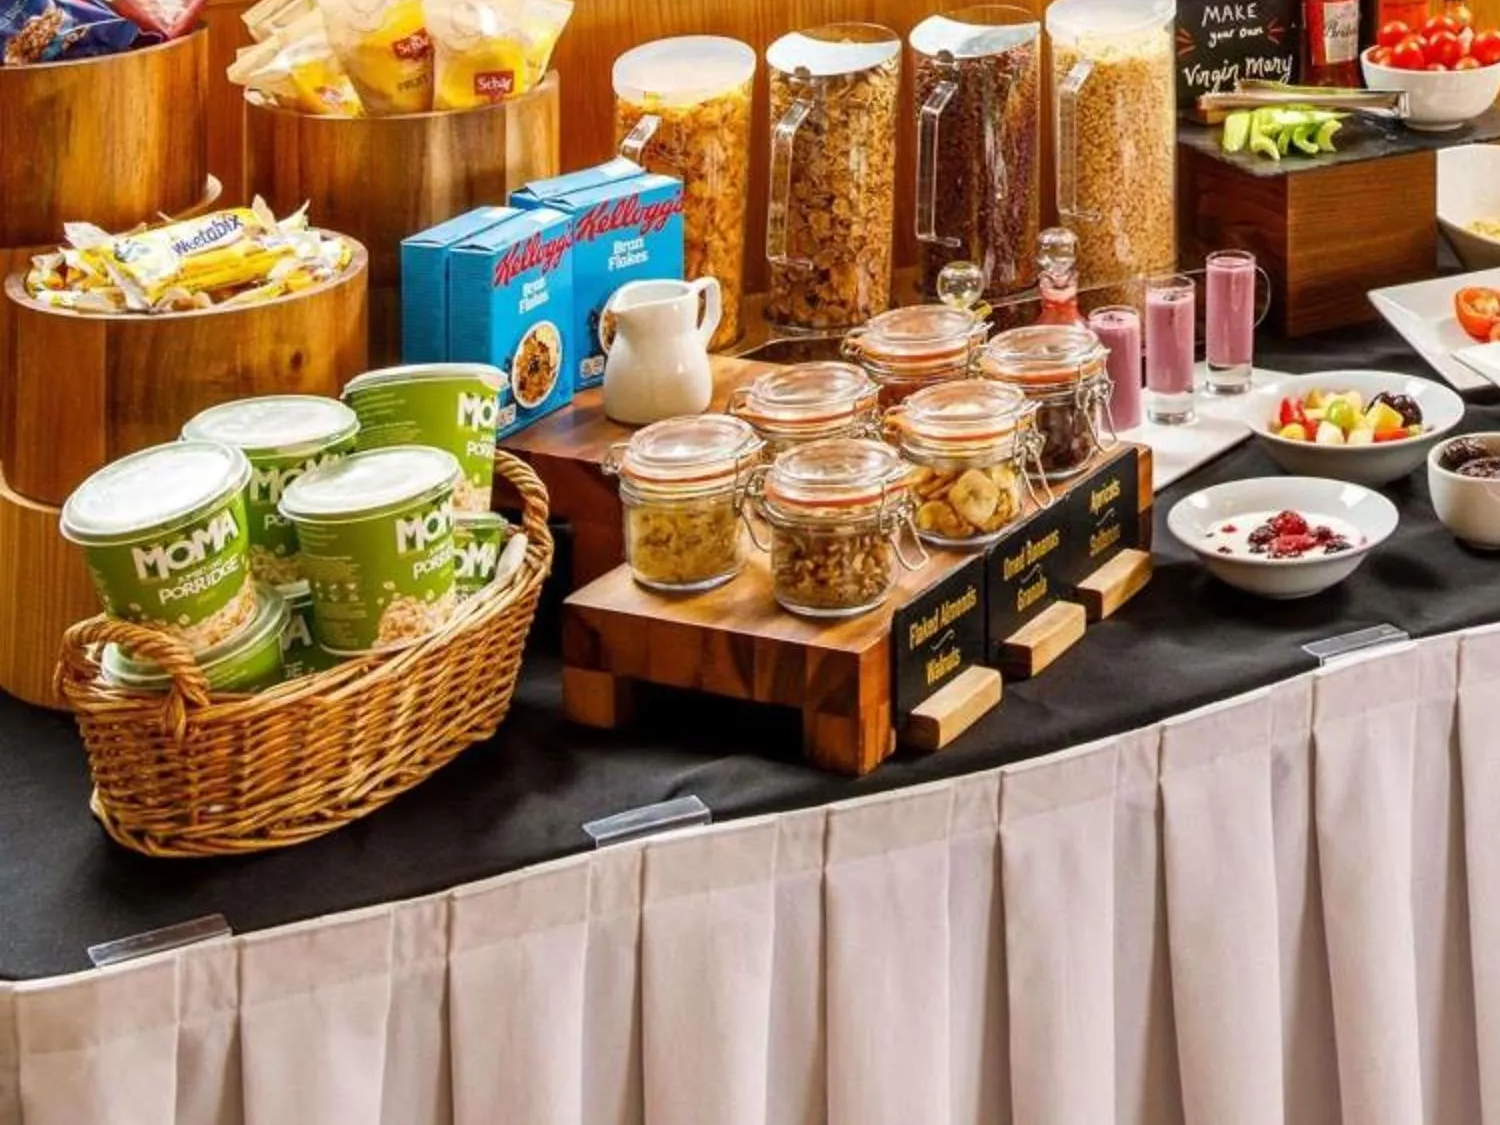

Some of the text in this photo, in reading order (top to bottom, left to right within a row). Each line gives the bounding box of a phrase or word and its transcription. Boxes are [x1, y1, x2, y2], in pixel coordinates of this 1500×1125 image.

[1201, 2, 1257, 27] MAKE
[1208, 26, 1264, 49] your own
[1182, 55, 1293, 95] Virgin Mary
[171, 213, 244, 256] Weetabix
[574, 189, 686, 241] Kellogg's
[494, 218, 573, 287] Kellogg's
[608, 251, 648, 272] Flakes
[613, 237, 644, 255] Bran
[131, 508, 239, 582] MOMA
[395, 500, 454, 555] MOM
[158, 553, 240, 605] PORRIDGE
